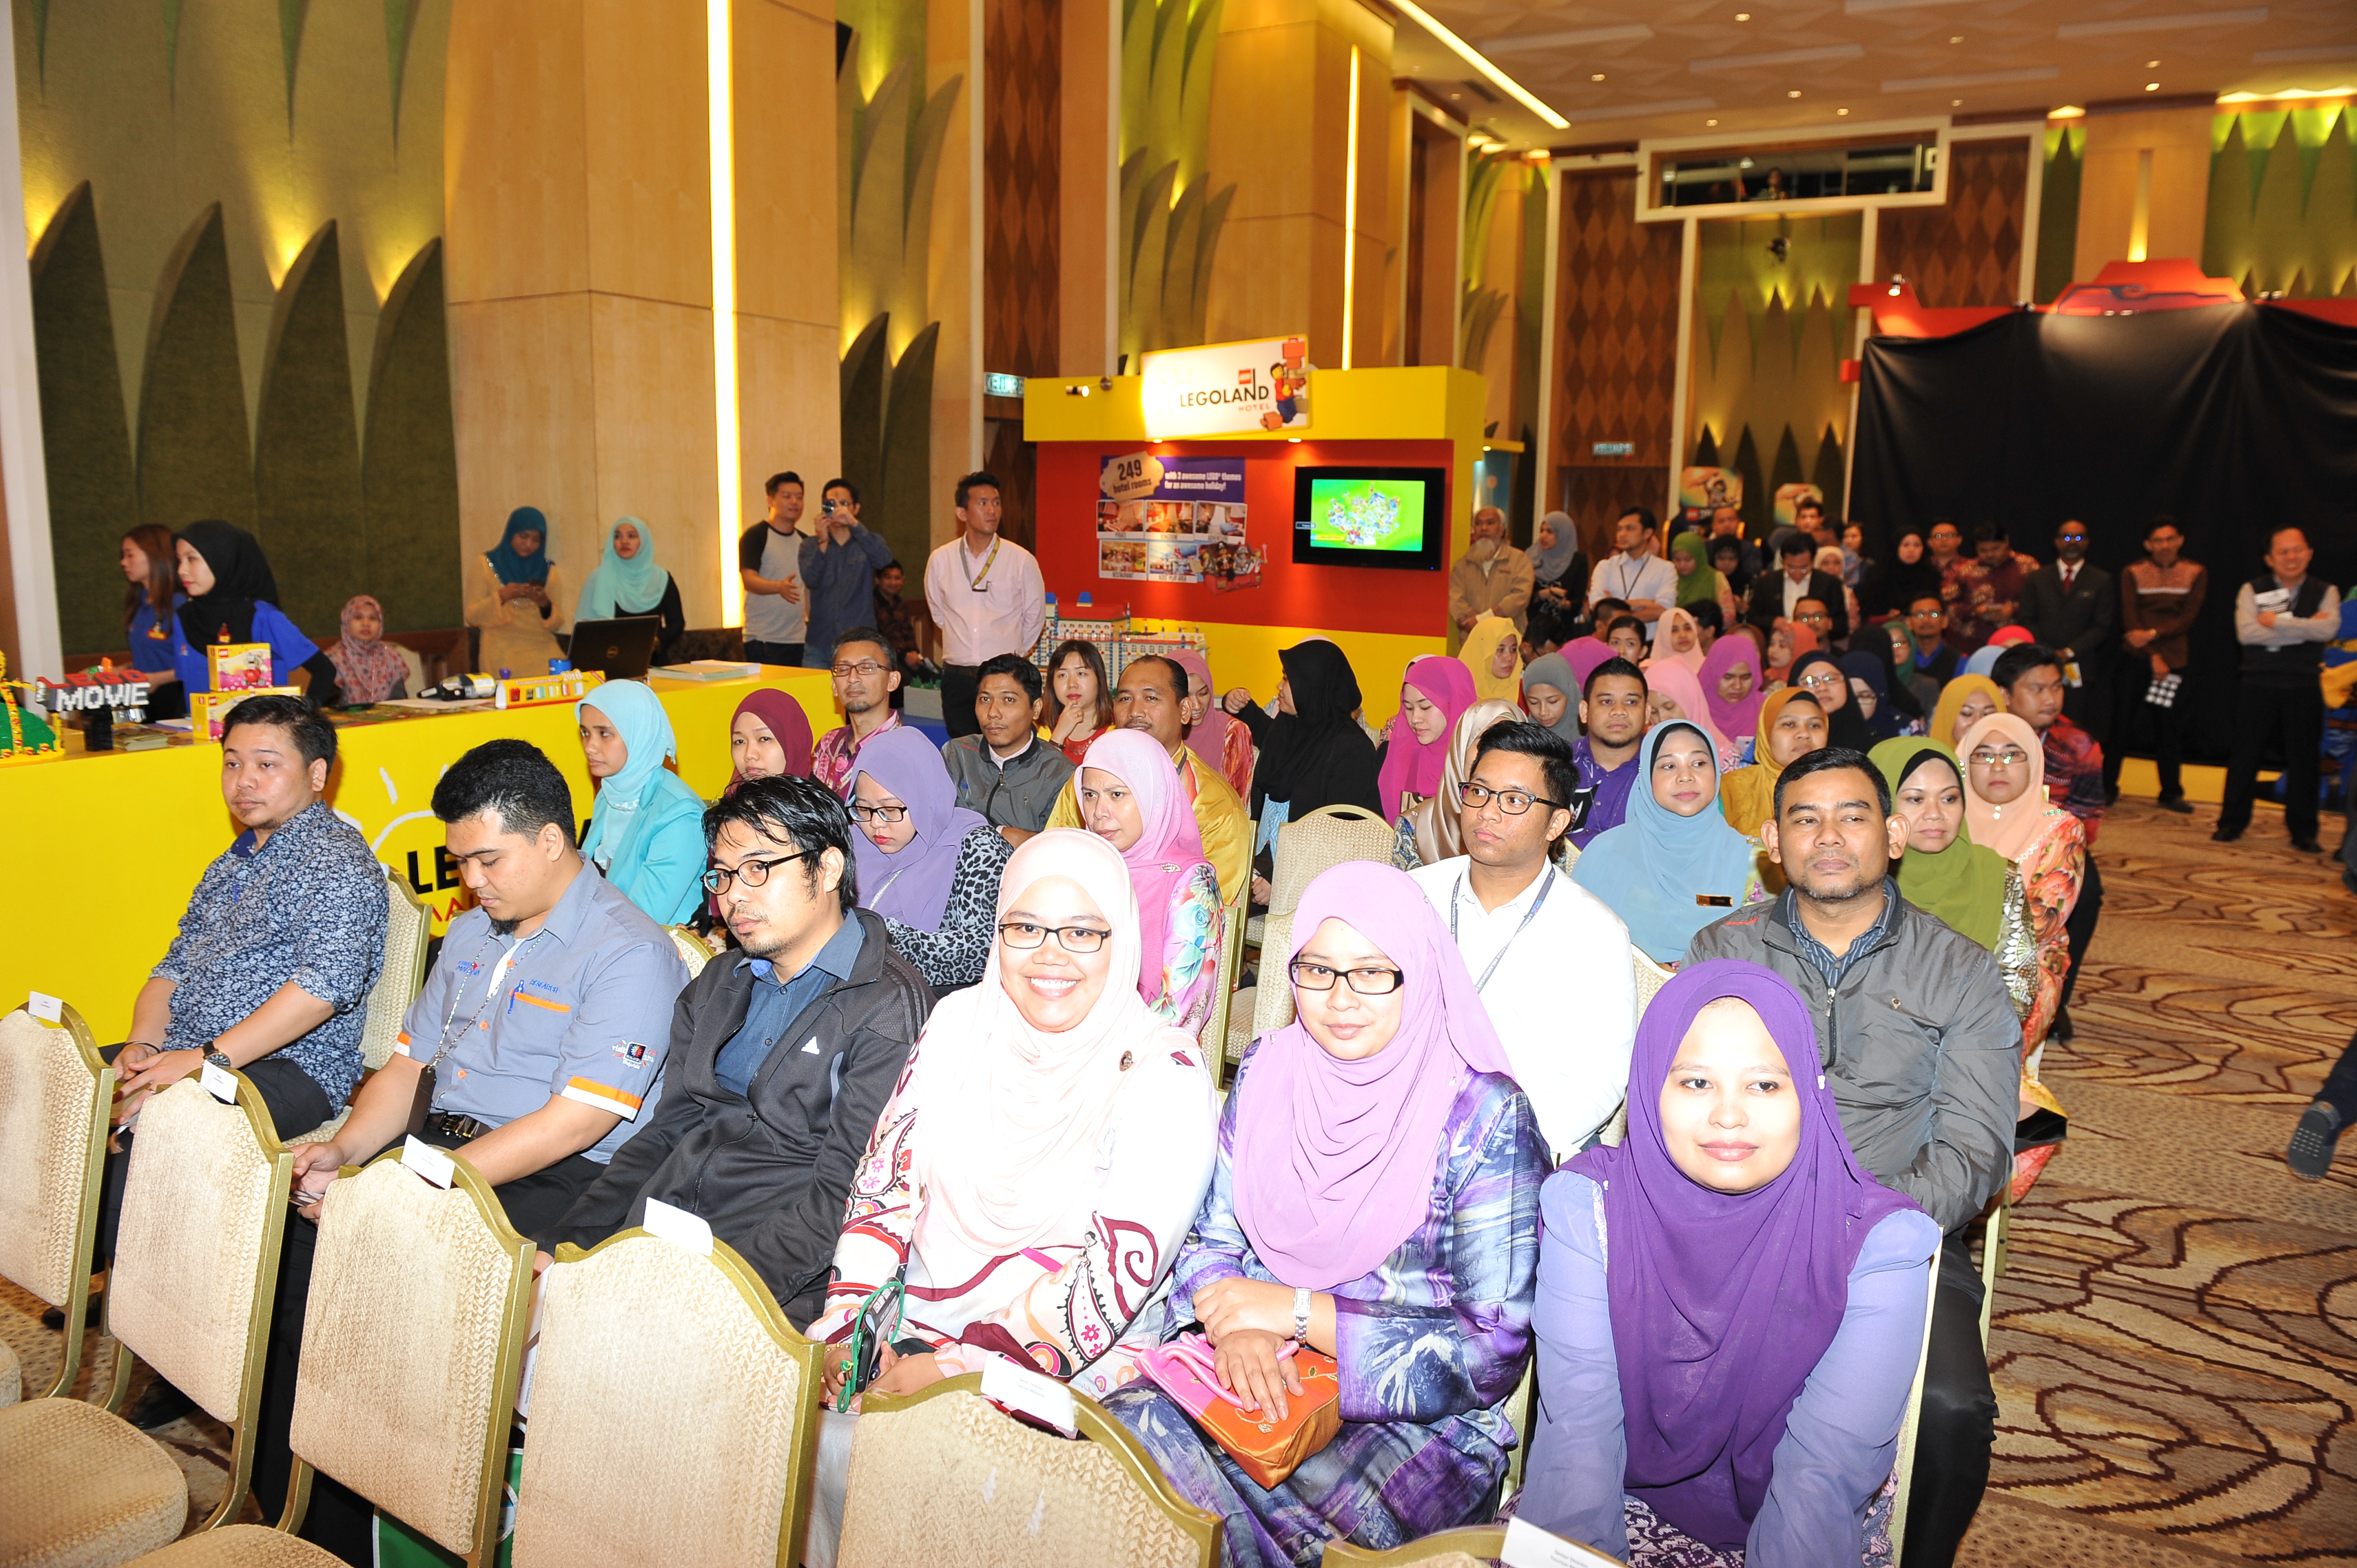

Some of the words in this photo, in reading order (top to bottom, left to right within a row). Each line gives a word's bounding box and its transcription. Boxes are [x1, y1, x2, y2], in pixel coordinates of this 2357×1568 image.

[1180, 368, 1269, 407] LEGOLAND
[1238, 403, 1270, 412] HOTEL
[1118, 459, 1142, 481] 249
[1222, 472, 1242, 481] themes
[1113, 482, 1130, 493] hotel
[1131, 478, 1151, 489] rooms
[37, 669, 149, 689] LEGO
[562, 670, 583, 682] 2016
[56, 682, 151, 711] MOVIE
[869, 896, 879, 909] MBAGA
[529, 979, 558, 993] RESEARCH
